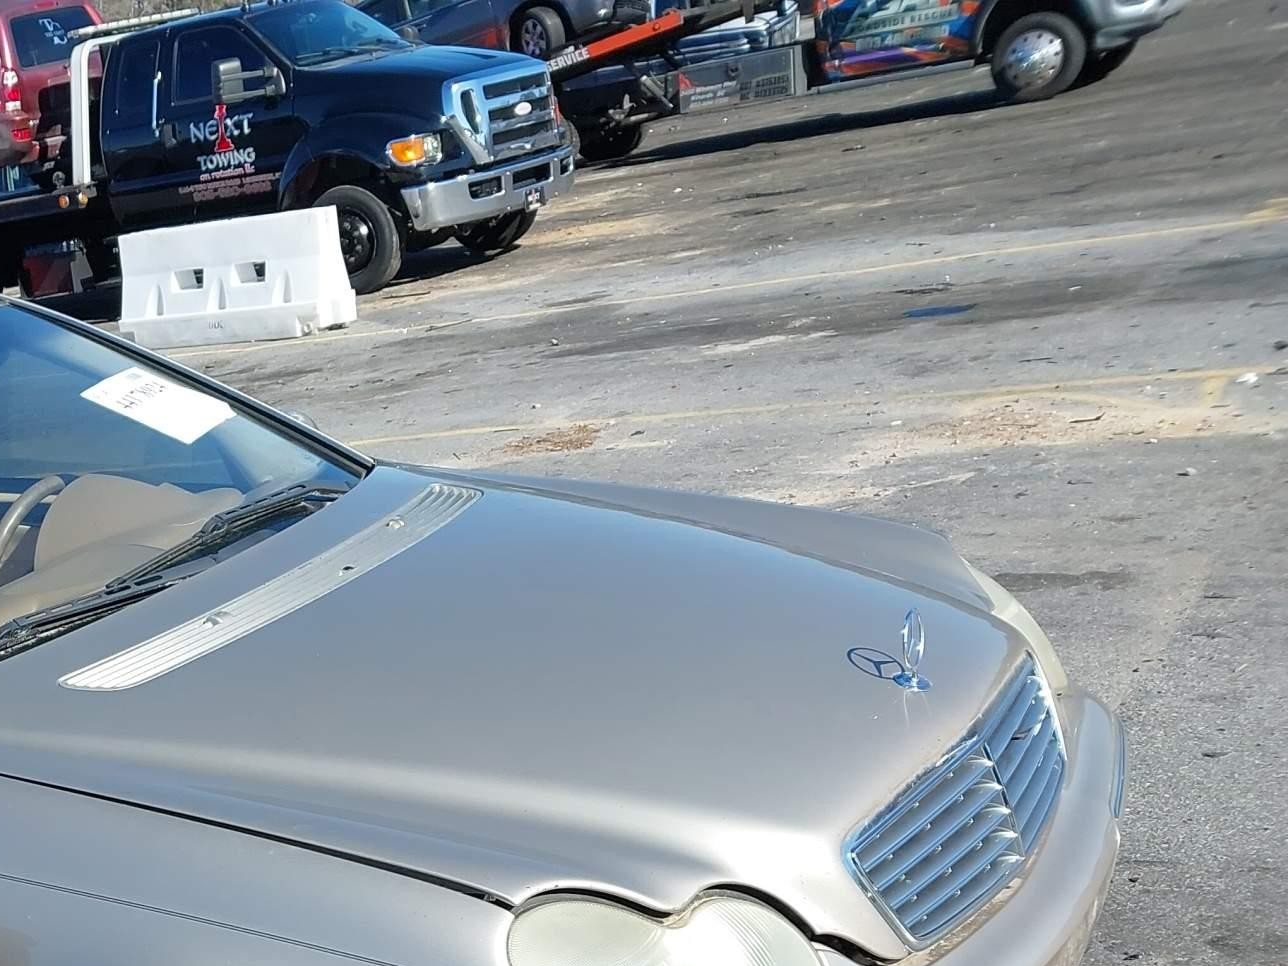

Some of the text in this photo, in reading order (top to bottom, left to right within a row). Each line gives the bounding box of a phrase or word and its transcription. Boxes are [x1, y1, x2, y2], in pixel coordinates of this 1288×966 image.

[546, 47, 590, 71] SERVICE
[189, 111, 254, 143] NEXT
[197, 147, 256, 171] TOWING
[212, 165, 244, 179] rotation
[244, 162, 256, 173] llc
